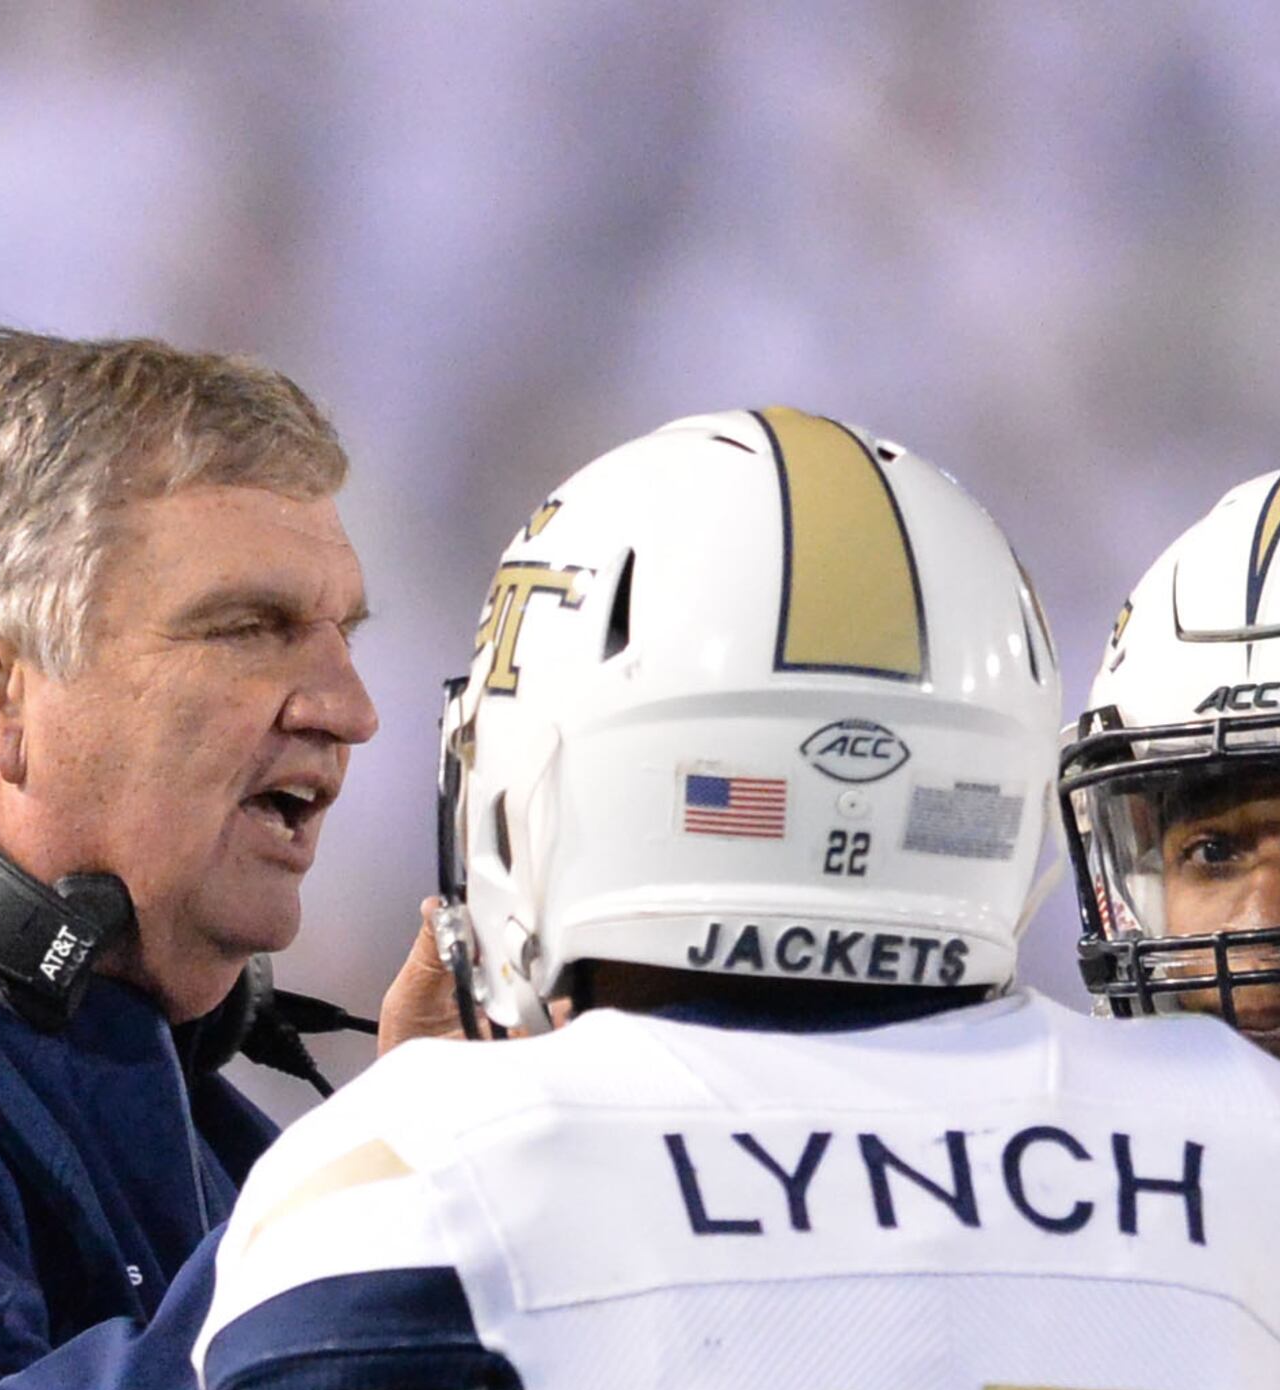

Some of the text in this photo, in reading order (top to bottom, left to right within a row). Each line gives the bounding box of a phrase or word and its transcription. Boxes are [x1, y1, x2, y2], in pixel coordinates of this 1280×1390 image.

[820, 735, 896, 758] ACC
[823, 829, 871, 876] 22
[40, 924, 78, 981] AT&T
[687, 922, 970, 986] JACKETS
[663, 1125, 1207, 1246] LYNCH
